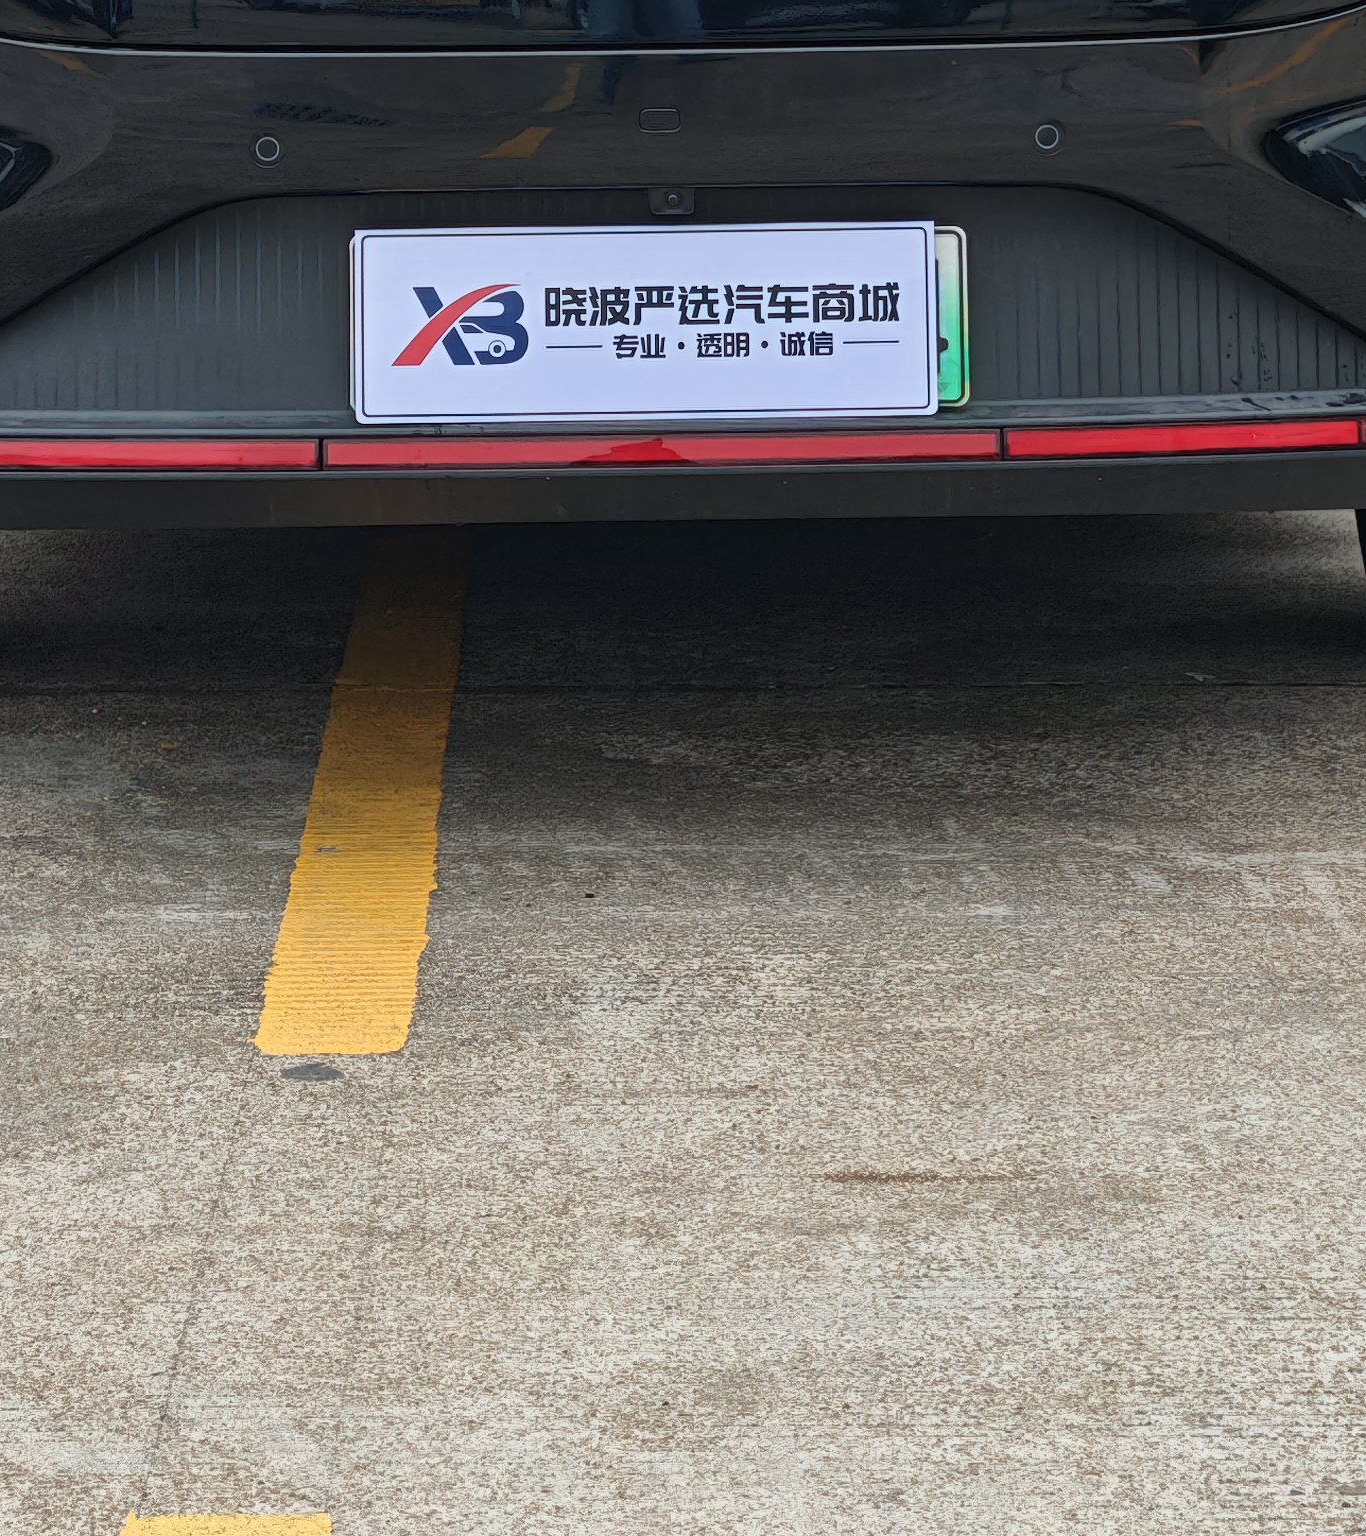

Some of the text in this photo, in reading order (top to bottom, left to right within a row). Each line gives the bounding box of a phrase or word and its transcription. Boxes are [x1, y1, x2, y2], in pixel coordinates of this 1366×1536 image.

[544, 282, 900, 327] 晓波严选汽车商城
